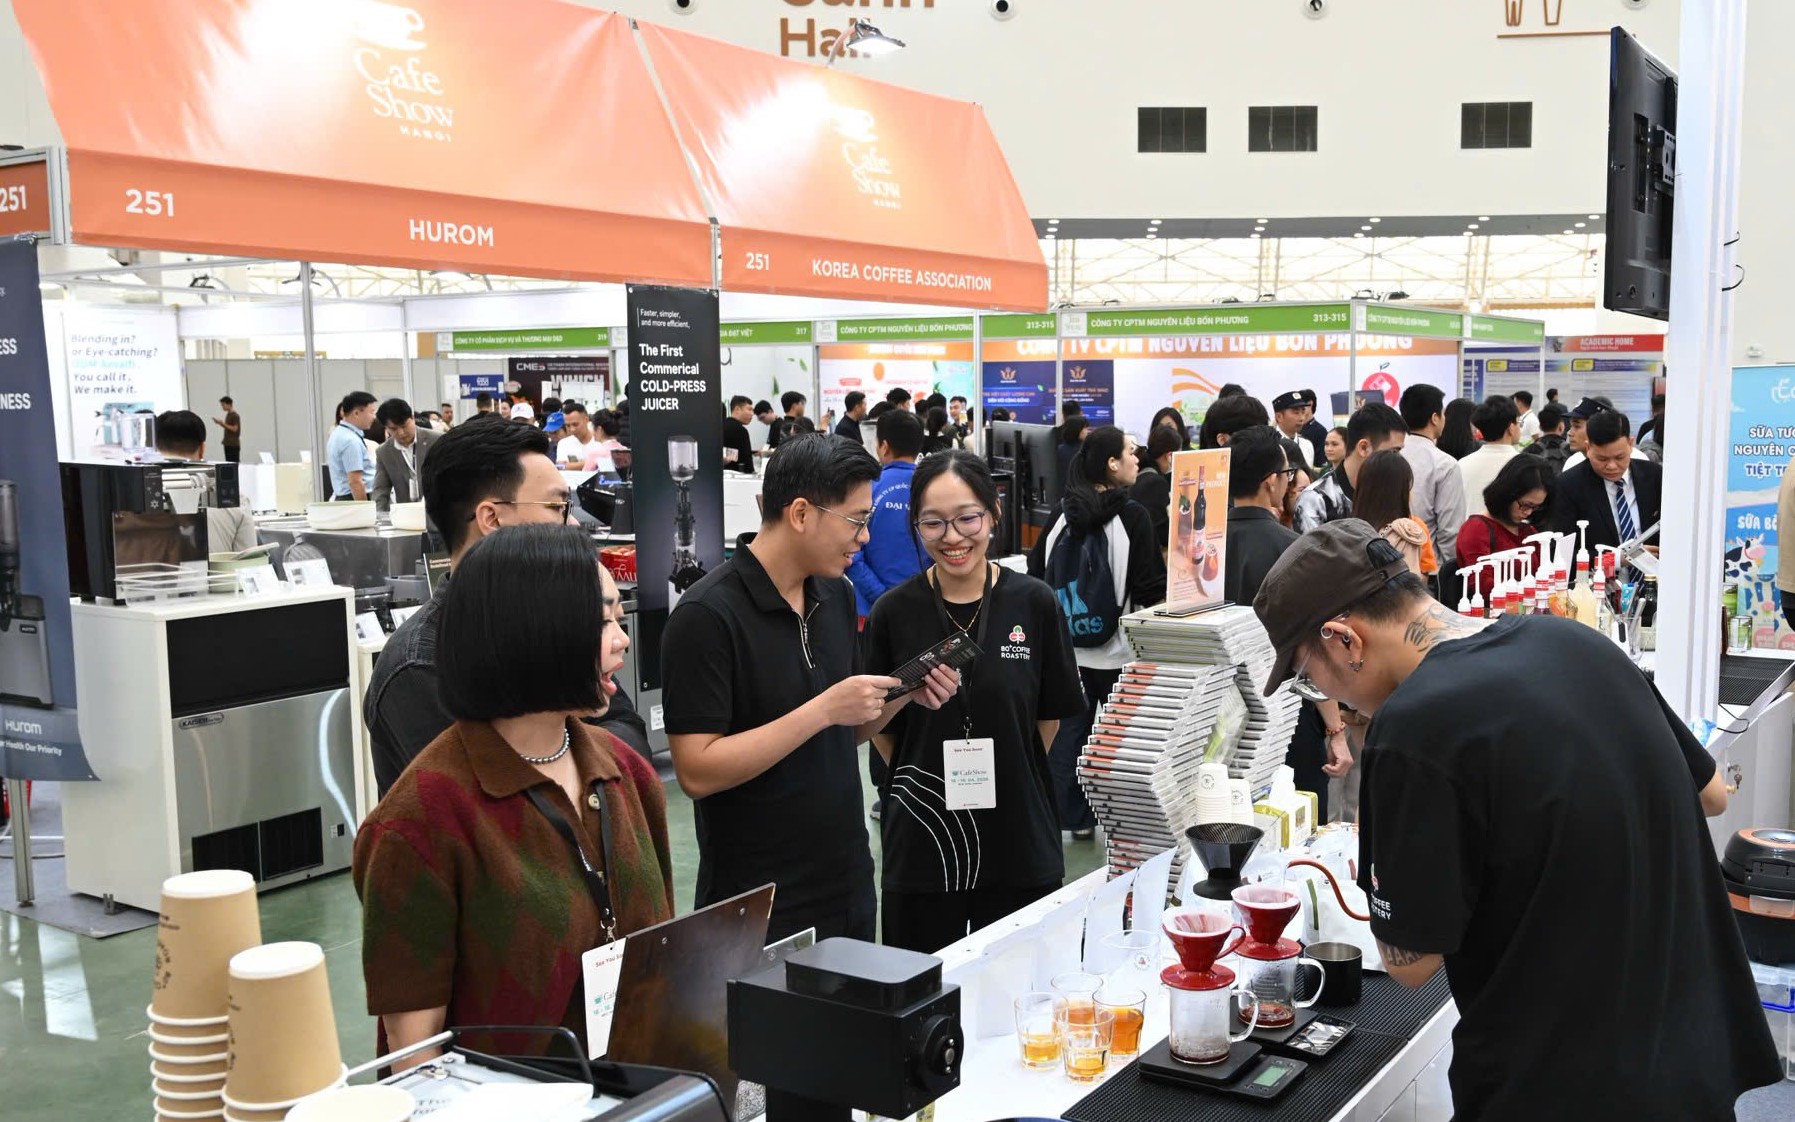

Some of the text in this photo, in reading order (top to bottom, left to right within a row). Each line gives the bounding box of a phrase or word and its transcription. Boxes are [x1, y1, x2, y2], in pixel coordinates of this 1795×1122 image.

[780, 18, 871, 58] Ha
[354, 48, 444, 95] Cafe
[366, 84, 453, 127] Show
[0, 185, 27, 212] 251
[125, 189, 174, 217] 251
[409, 219, 494, 247] HUROM
[746, 253, 770, 271] 251
[812, 260, 992, 291] KOREA COFFEE ASSOCIATION
[640, 309, 681, 319] Faster, simpler,
[1313, 313, 1347, 322] 313-315
[1026, 321, 1054, 329] 313-315
[1113, 319, 1122, 327] TY
[1124, 319, 1145, 327] CPTM
[71, 334, 136, 346] Blending in?
[86, 347, 158, 358] Eye-catching?
[639, 344, 683, 357] The First
[640, 362, 699, 374] Commerical
[74, 373, 94, 381] You
[96, 372, 116, 381] call
[74, 385, 90, 394] We
[94, 385, 123, 394] make
[640, 380, 706, 392] COLD-PRESS
[641, 398, 679, 410] JUICER
[1749, 425, 1774, 439] SỮA
[1734, 442, 1784, 456] NGUYÊN
[1746, 462, 1772, 478] TIỆT
[885, 501, 903, 511] ĐẠI
[1737, 513, 1760, 529] SỮA
[6, 740, 25, 750] Health
[25, 743, 37, 752] Our
[38, 744, 62, 756] Priority
[606, 956, 616, 965] You
